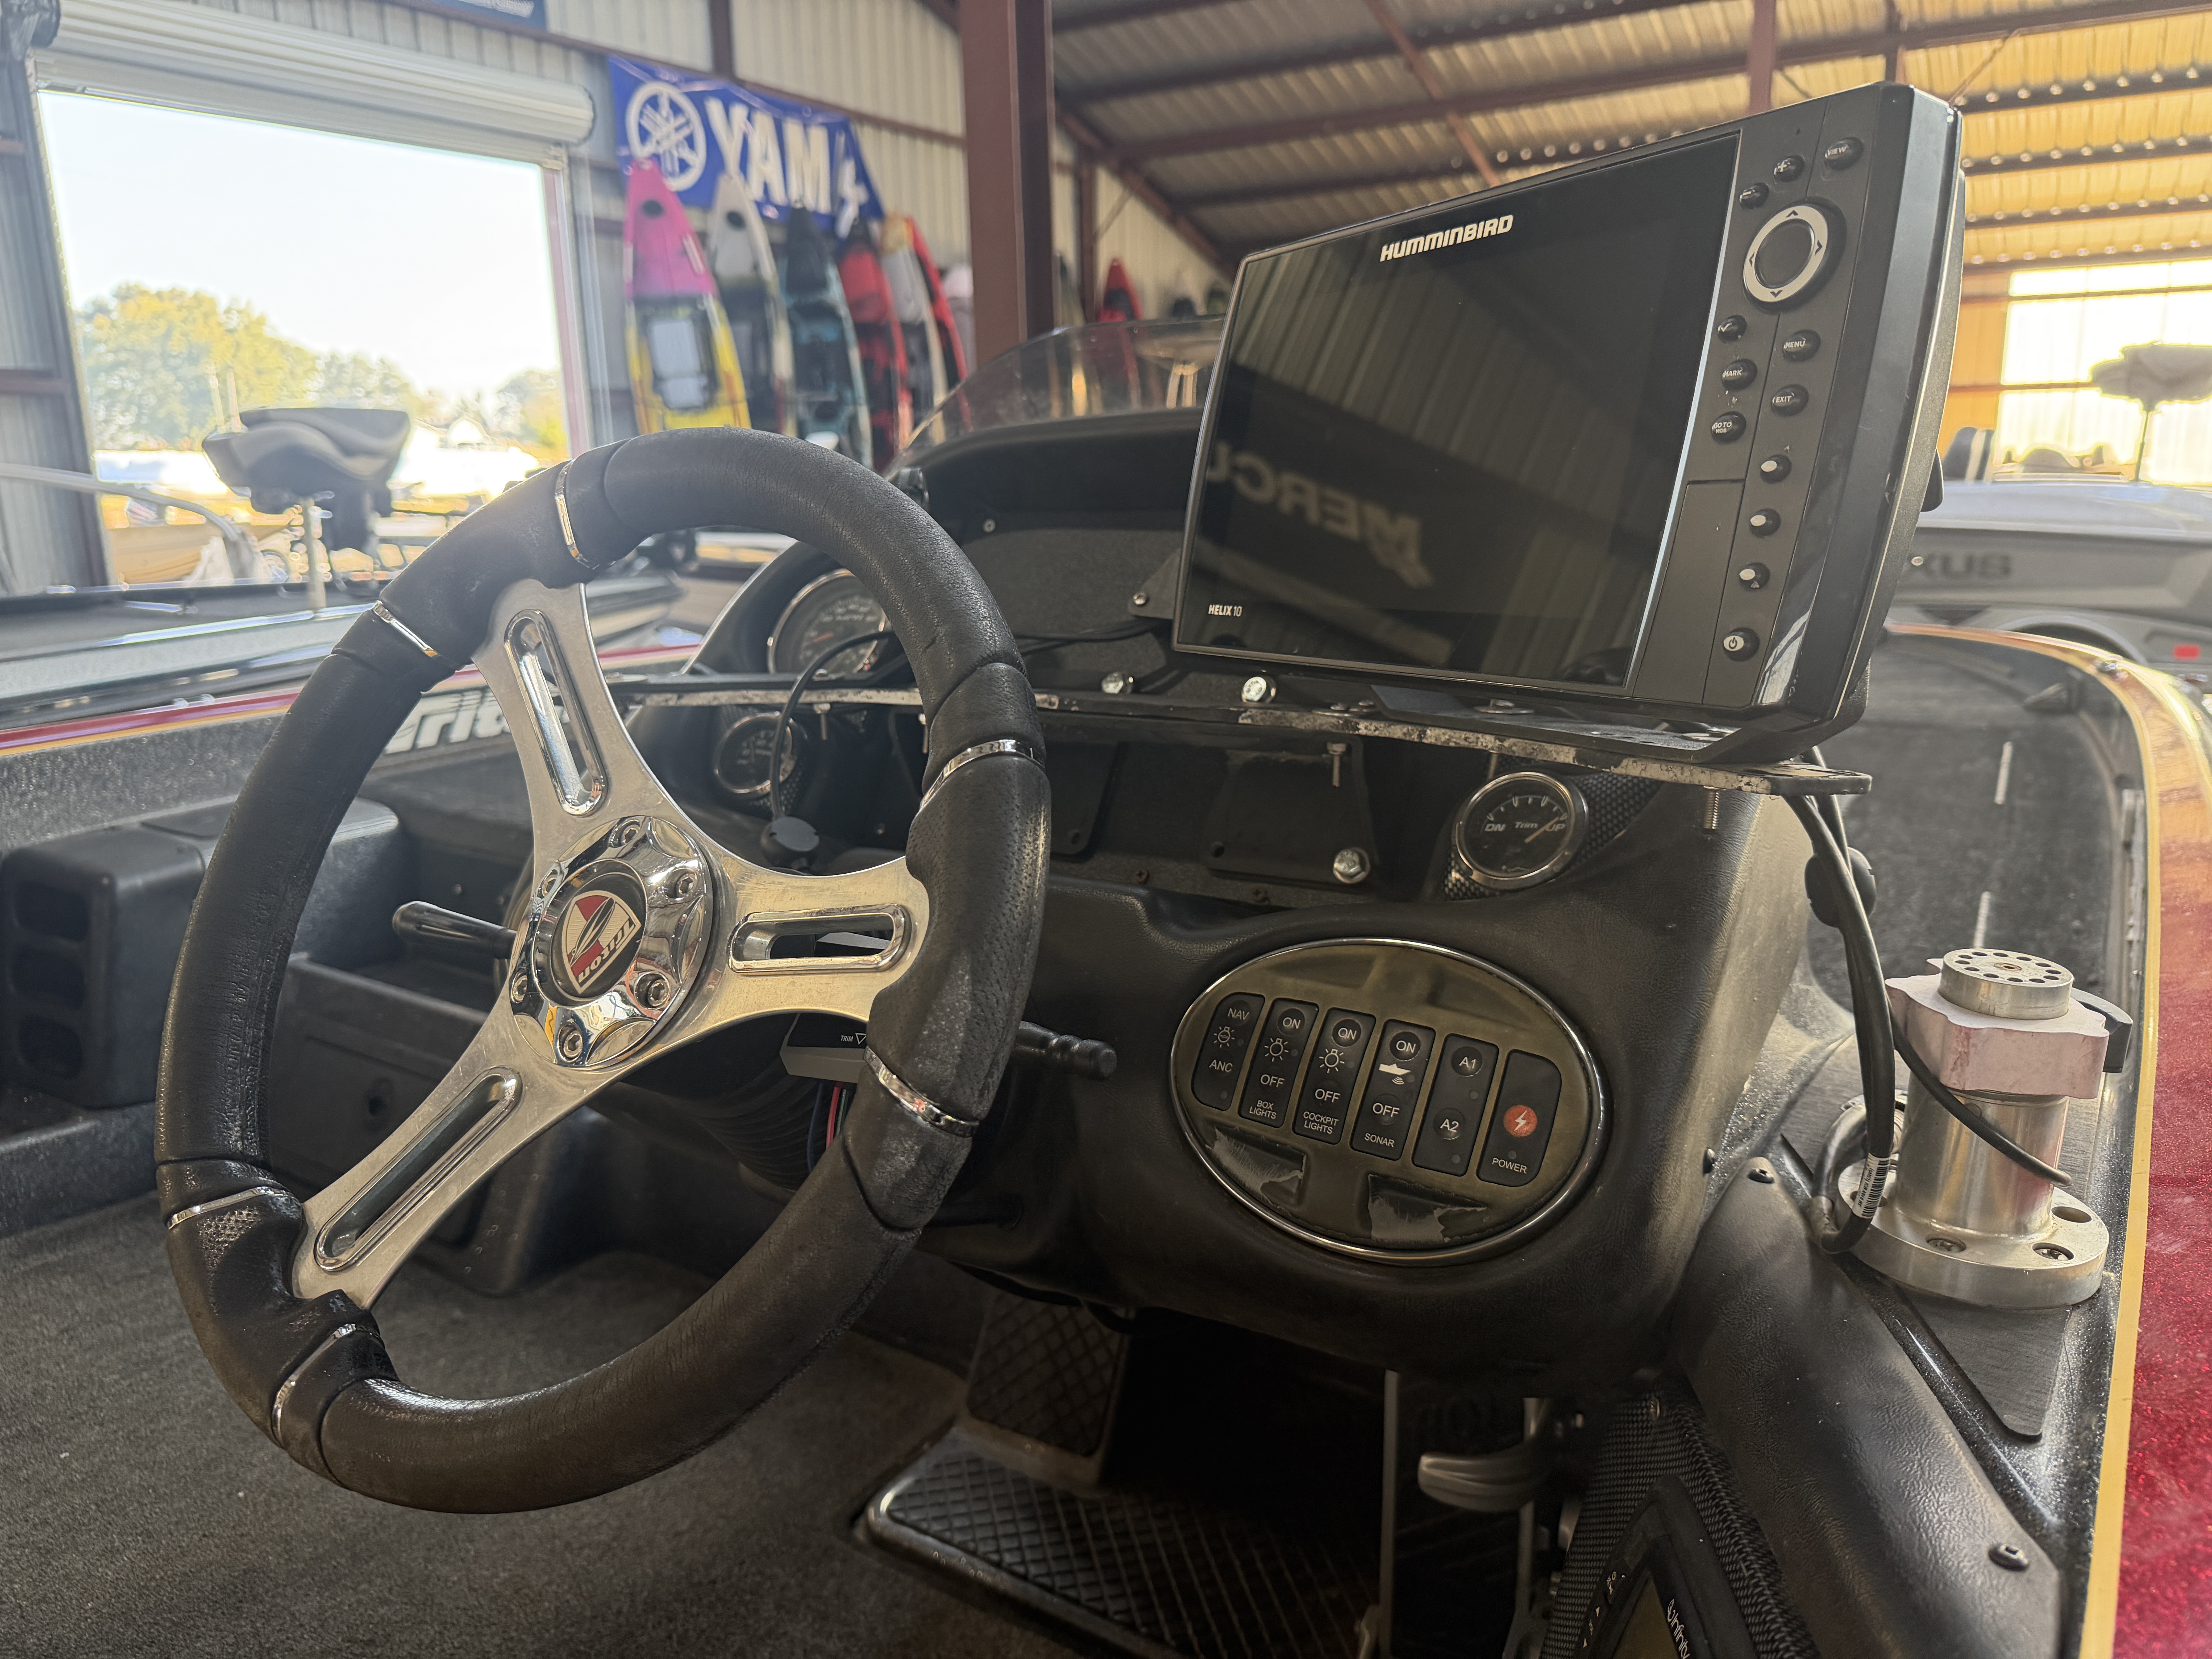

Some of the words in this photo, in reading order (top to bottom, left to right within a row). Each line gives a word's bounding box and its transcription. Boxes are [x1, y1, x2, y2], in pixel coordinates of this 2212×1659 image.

[1827, 146, 1847, 156] VIEW
[705, 98, 869, 239] YAM
[1379, 215, 1513, 262] HUMMINBIRD
[1208, 605, 1233, 616] HELIX
[1233, 606, 1243, 617] 10
[1228, 1008, 1250, 1020] NAV
[1283, 1017, 1300, 1029] ON
[1338, 1027, 1357, 1040] ON
[1396, 1041, 1416, 1053] ON
[1209, 1059, 1233, 1072] ANC
[1459, 1056, 1477, 1069] A1
[1260, 1074, 1285, 1087] OFF
[1314, 1089, 1340, 1103] OFF
[1257, 1100, 1274, 1110] BOX
[1372, 1103, 1400, 1118] OFF
[1249, 1106, 1277, 1120] LIGHTS
[1303, 1111, 1339, 1126] COCKPIT
[1304, 1120, 1333, 1135] LIGHTS
[1440, 1119, 1459, 1133] A2
[1364, 1132, 1395, 1147] SONAR
[1492, 1157, 1527, 1174] POWER
